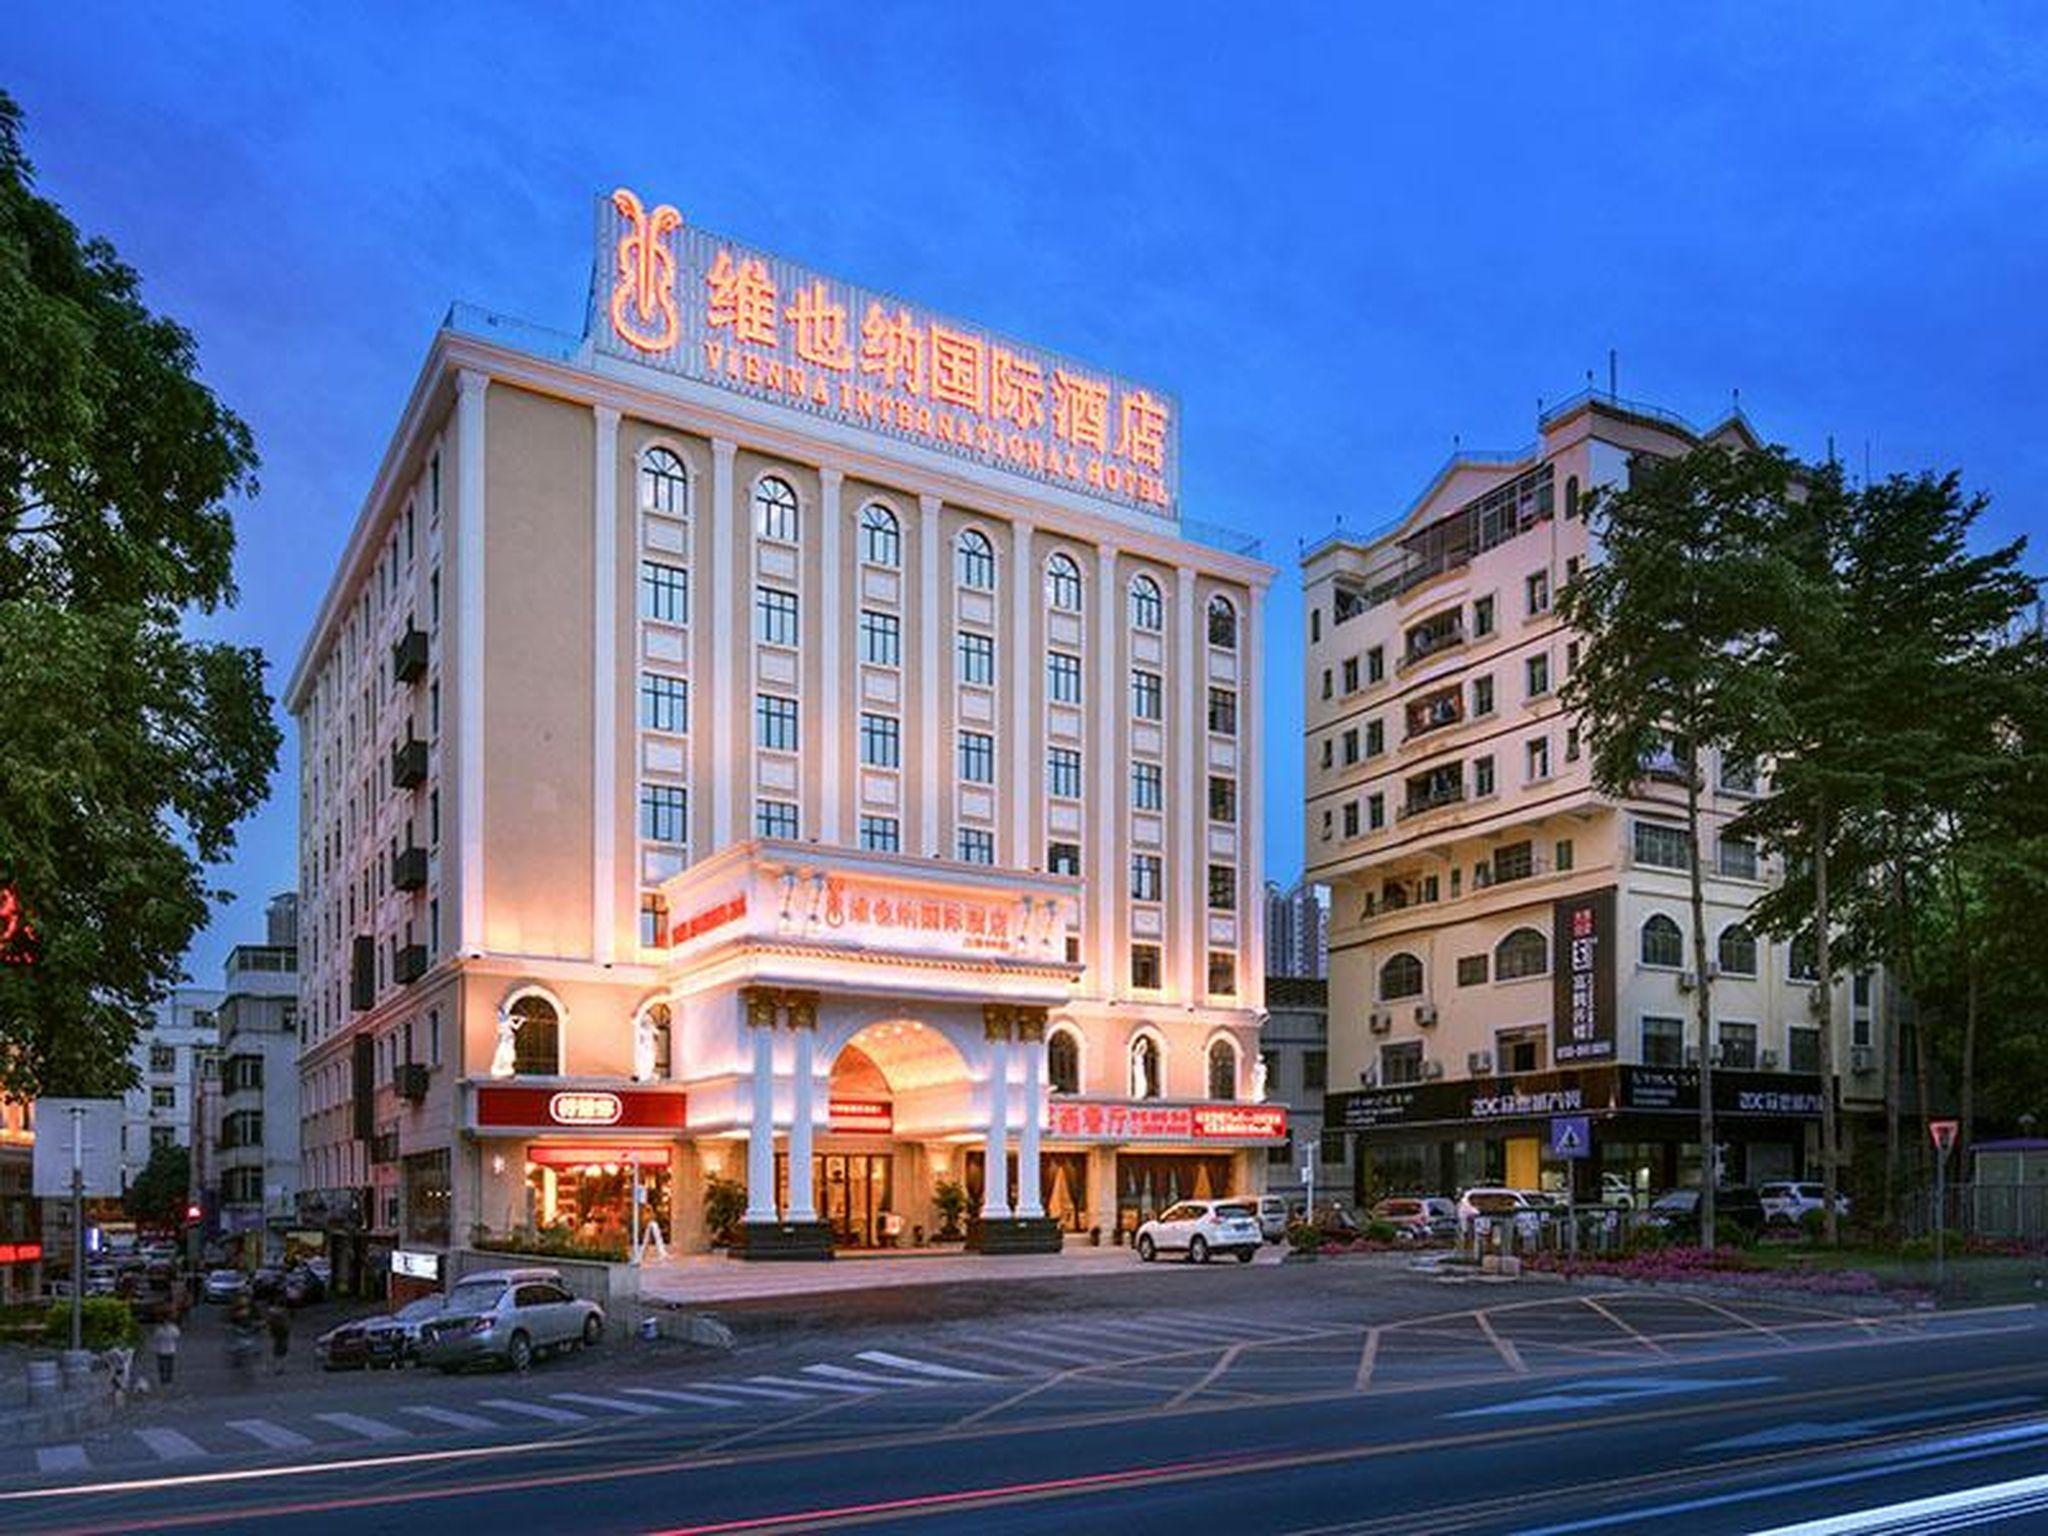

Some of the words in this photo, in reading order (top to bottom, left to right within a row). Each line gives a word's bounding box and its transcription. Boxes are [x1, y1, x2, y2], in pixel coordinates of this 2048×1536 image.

[703, 340, 830, 405] VIENNA
[838, 383, 1081, 480] INTERNATIONAL
[1086, 458, 1170, 508] HOTEL
[705, 250, 1170, 473] 维也纳国际酒店
